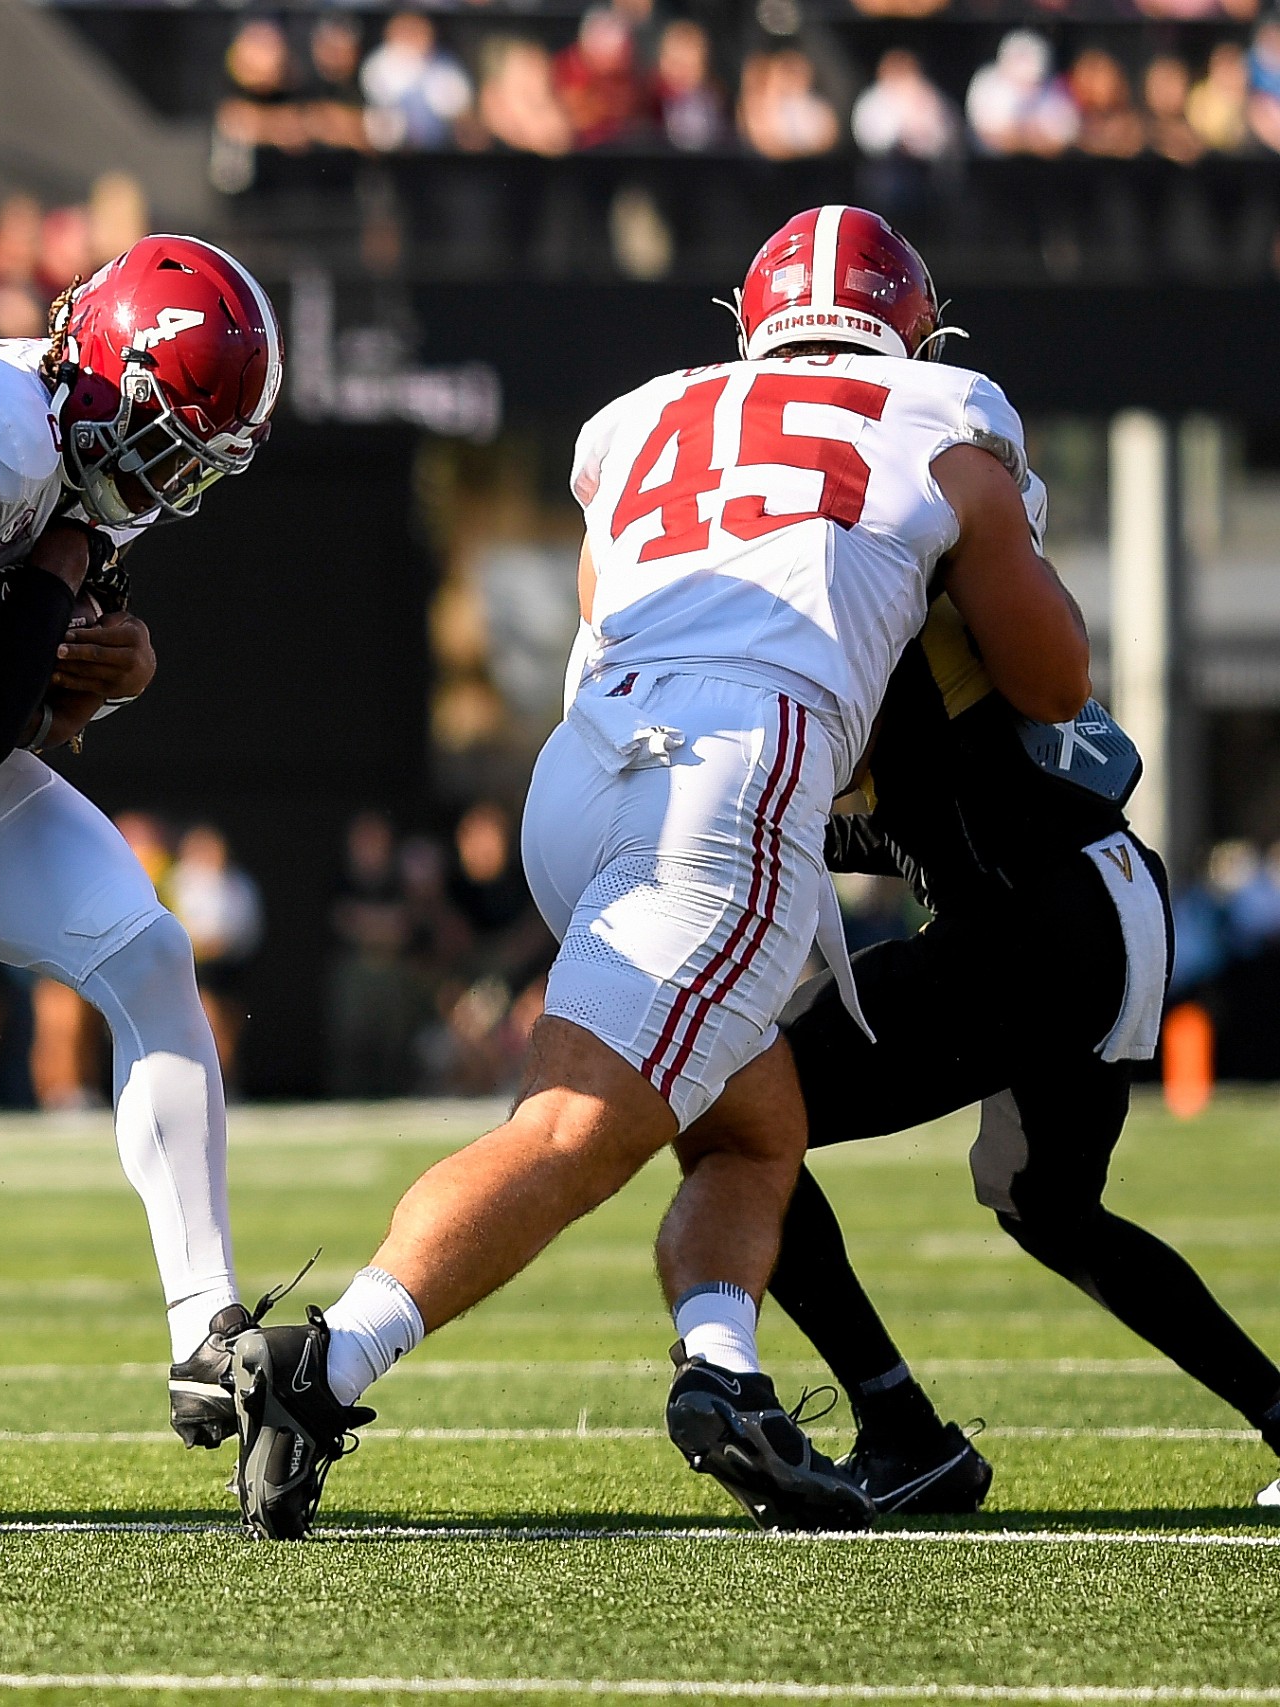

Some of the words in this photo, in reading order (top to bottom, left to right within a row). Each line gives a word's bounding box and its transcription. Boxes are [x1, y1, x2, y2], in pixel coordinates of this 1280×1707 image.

[143, 306, 206, 350] 4
[767, 313, 839, 335] CRIMSON
[844, 315, 882, 337] TIDE
[611, 373, 891, 565] 45
[1098, 843, 1134, 884] V
[288, 1432, 305, 1478] ALPHA
